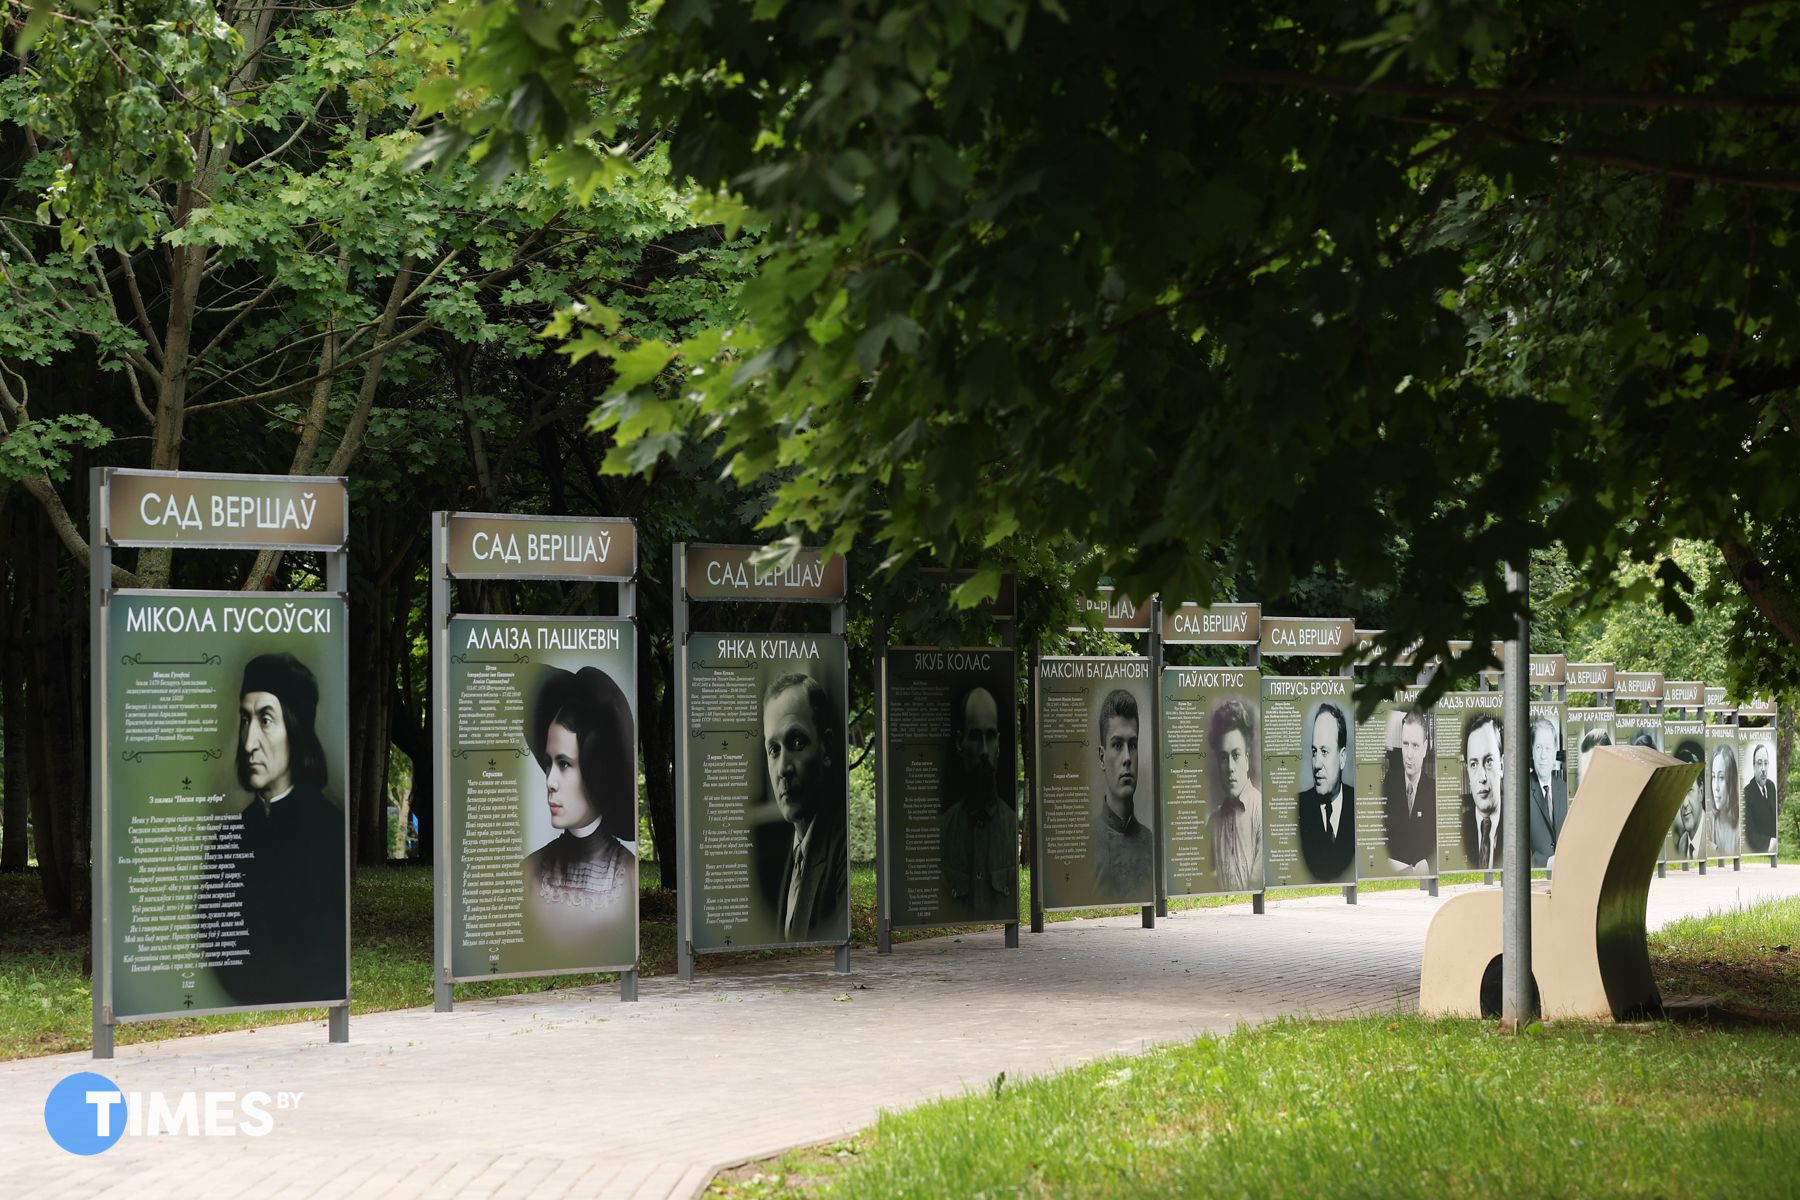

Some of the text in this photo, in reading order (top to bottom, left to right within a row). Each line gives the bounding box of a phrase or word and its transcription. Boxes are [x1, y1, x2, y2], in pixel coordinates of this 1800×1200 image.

[141, 492, 316, 530] САД ВЕРШАЎ
[472, 530, 611, 564] САД ВЕРШАЎ
[707, 561, 748, 588] САД
[127, 603, 331, 633] МІКОЛА ГУСОЎСКІ
[1174, 611, 1248, 634] САД ВЕРШАЎ
[466, 627, 619, 649] АЛАІЗА ПАШКЕВІЧ
[1272, 626, 1342, 646] САД ВЕРШАЎ
[718, 640, 820, 659] ЯНКА КУПАЛА
[915, 653, 990, 671] ЯКУБ КОЛАС
[1041, 663, 1148, 679] МАКСІМ БАГДАНОВІЧ
[1179, 670, 1243, 687] ПАЎЛЮК ТРУС
[1567, 670, 1607, 685] АД ВЕРШАЎ
[1616, 678, 1656, 693] АД ВЕРШАЎ
[1271, 680, 1345, 695] ПЯТРУСЬ БРОЎКА
[1672, 687, 1697, 700] ВЕРШАЎ
[1438, 695, 1503, 709] КАДЗЬ КУЛЯШОЎ
[1637, 719, 1662, 728] КАРЫЗНА
